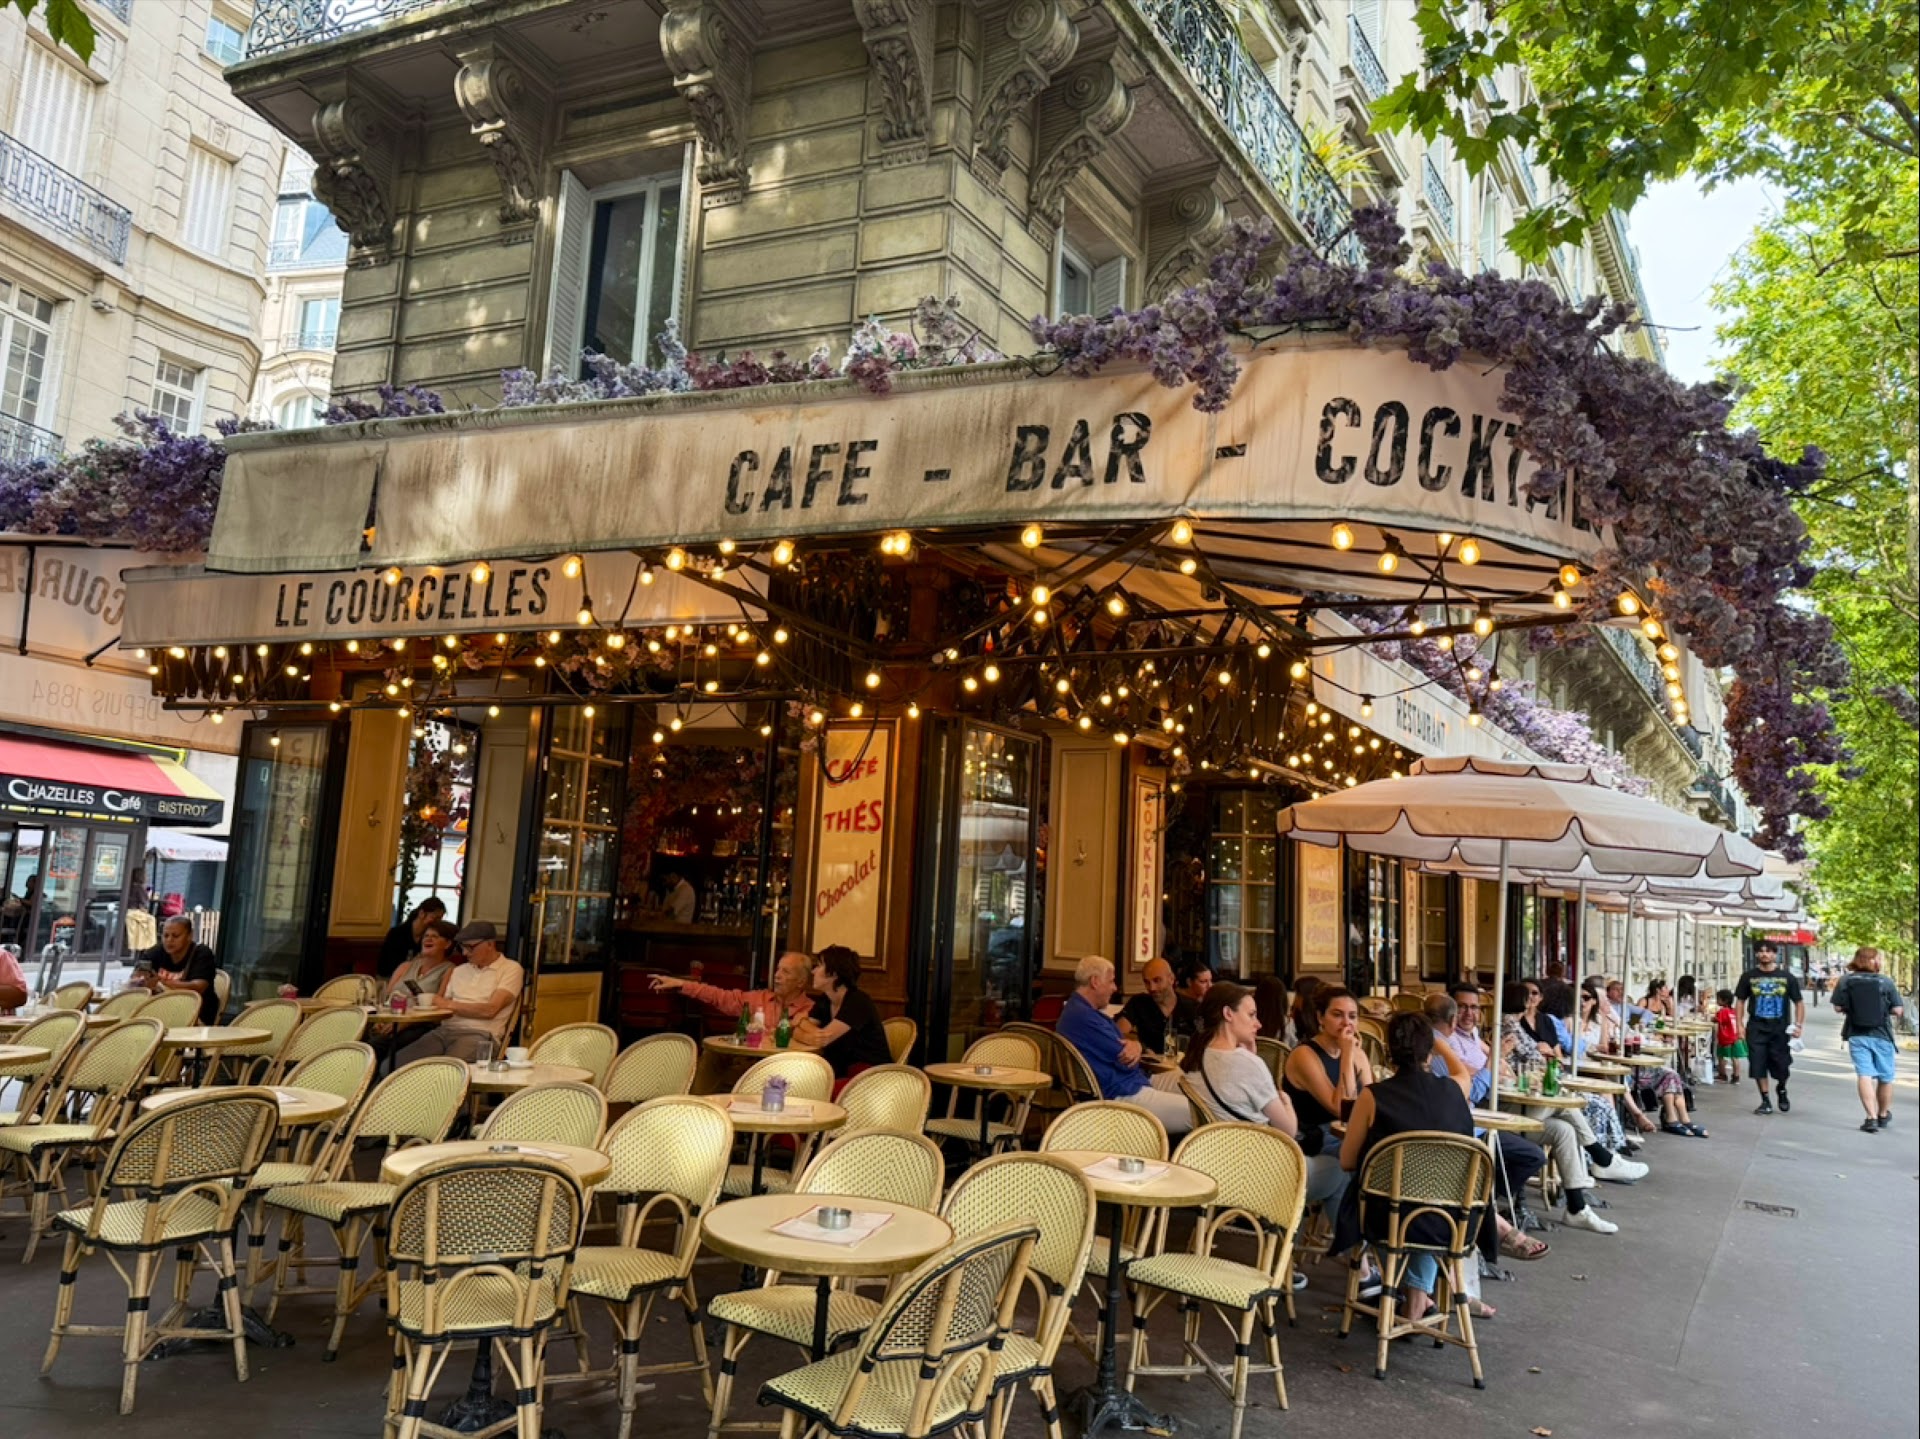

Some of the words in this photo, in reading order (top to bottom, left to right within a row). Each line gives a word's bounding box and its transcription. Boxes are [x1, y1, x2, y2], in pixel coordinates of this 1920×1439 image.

[724, 439, 879, 515] CAFE
[1005, 411, 1152, 492] BAR
[275, 582, 313, 627] LE
[325, 567, 550, 625] COURCELLES
[826, 756, 878, 787] CAFÉ
[8, 779, 95, 805] CHAZELLES
[102, 790, 142, 811] Café
[158, 801, 208, 817] BISTROT
[823, 800, 882, 833] THÉS
[815, 850, 877, 917] Chocolat
